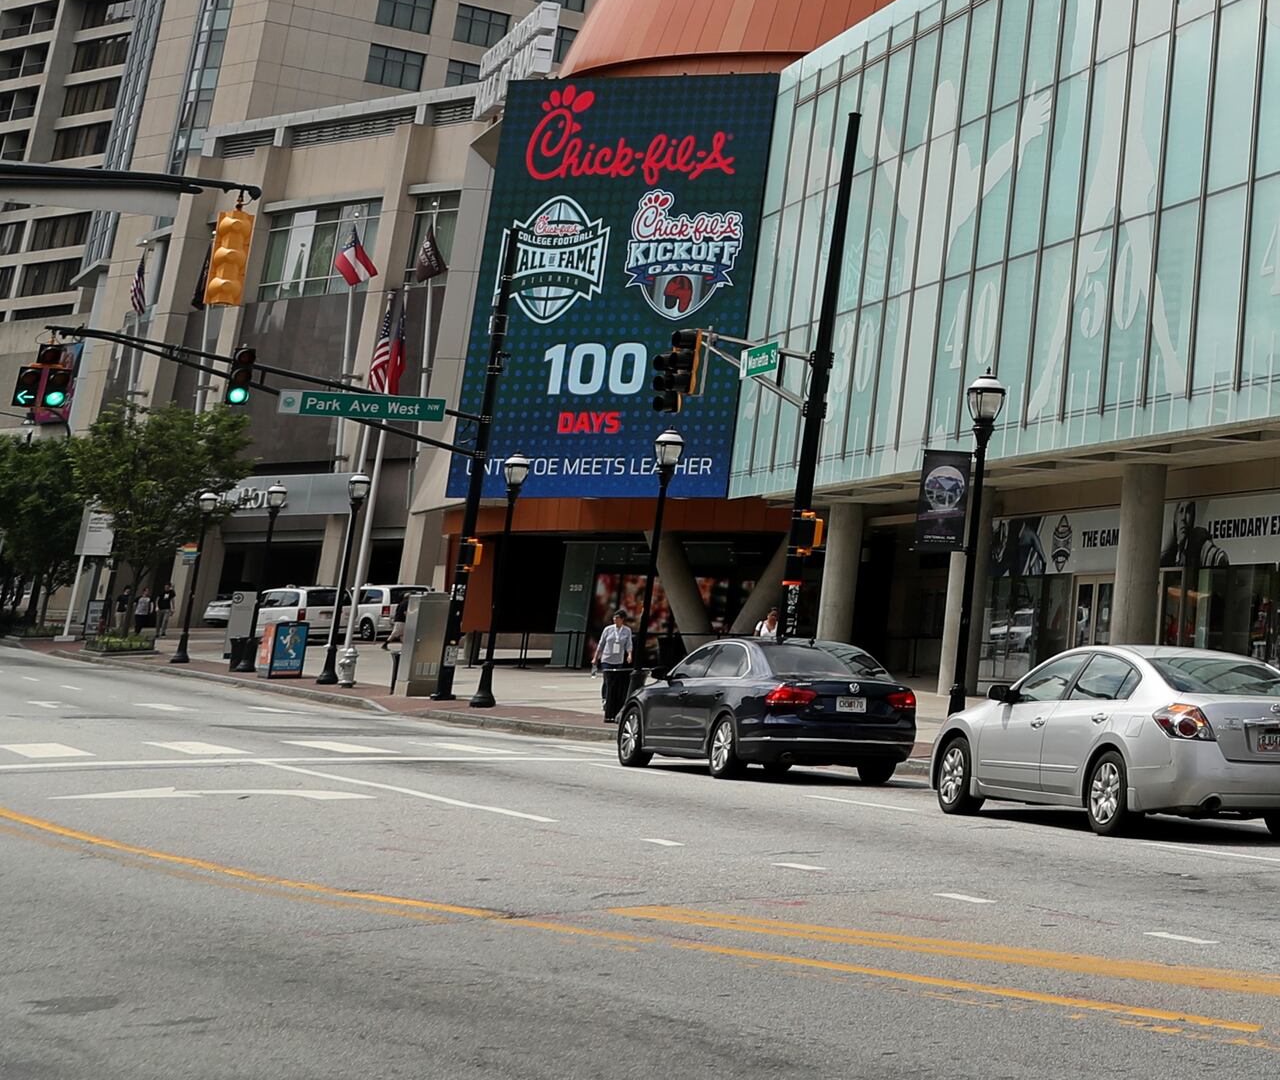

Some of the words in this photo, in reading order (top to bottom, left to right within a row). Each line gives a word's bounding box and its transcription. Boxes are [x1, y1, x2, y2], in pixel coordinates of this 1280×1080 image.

[526, 90, 736, 185] Chick-fil-A
[637, 195, 739, 240] Chick-fil-A
[518, 231, 552, 246] COLLEGE
[552, 230, 594, 246] FOOTBALL
[517, 248, 546, 273] ALL
[558, 242, 599, 276] FAME
[628, 241, 739, 269] KICKOFF
[648, 263, 715, 275] GAME
[1079, 231, 1142, 340] 50
[944, 281, 998, 369] 40
[543, 342, 648, 396] 100
[306, 397, 341, 411] Park
[349, 400, 380, 413] Ave
[387, 401, 421, 416] West
[557, 411, 621, 434] DAYS
[562, 458, 625, 475] MEETS
[630, 458, 712, 475] LEAHER
[1082, 530, 1099, 548] THE
[1208, 516, 1270, 539] LEGENDARY
